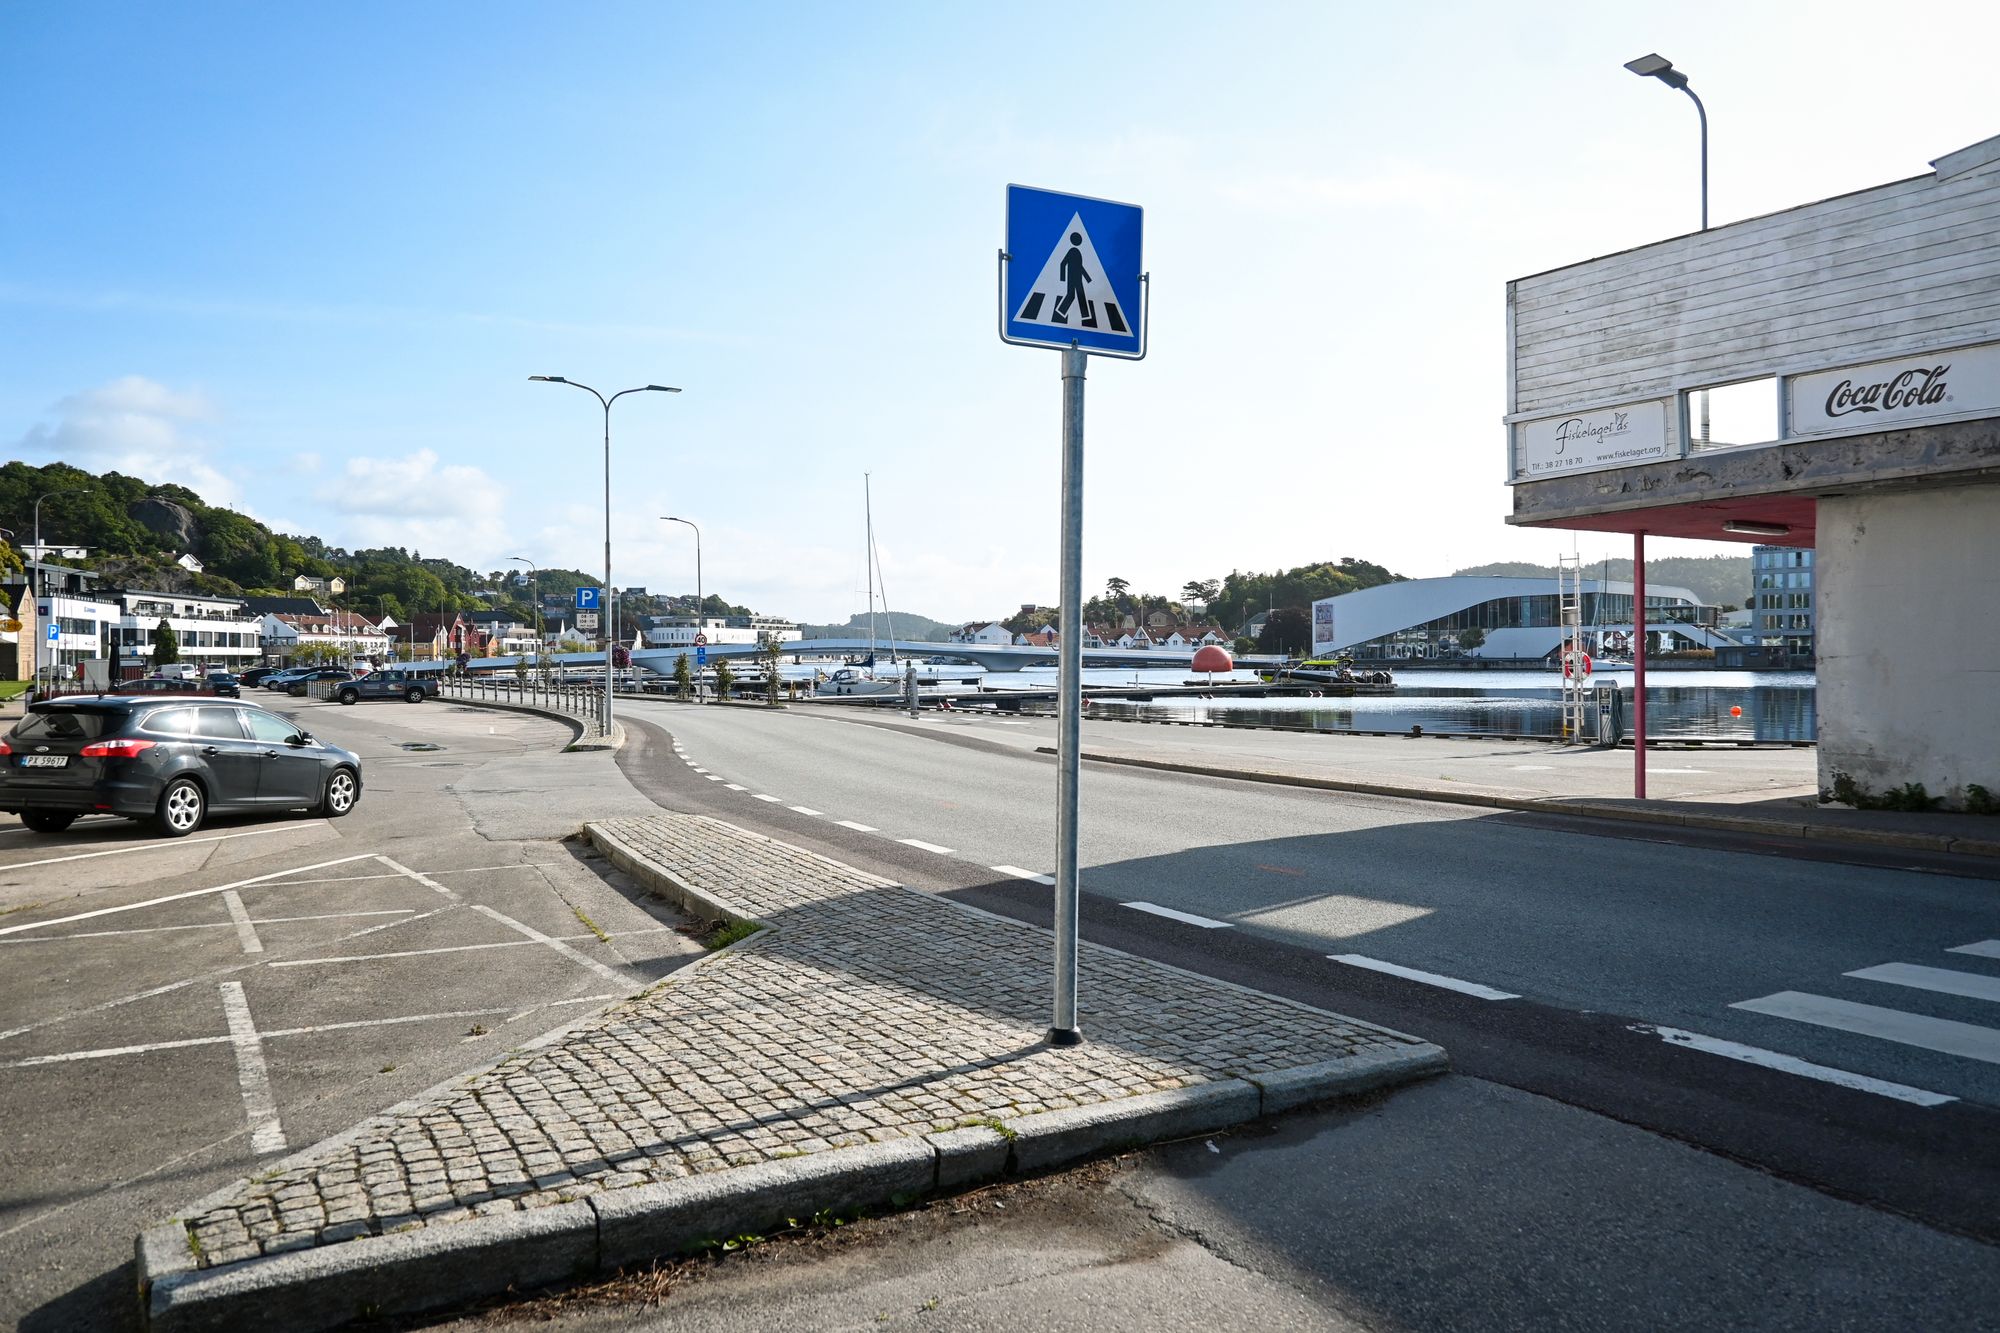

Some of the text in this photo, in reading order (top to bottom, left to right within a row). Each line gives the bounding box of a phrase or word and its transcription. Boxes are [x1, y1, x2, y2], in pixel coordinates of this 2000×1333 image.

[1825, 364, 1951, 418] Coca-Cola
[1555, 418, 1613, 455] Fiskelaget
[1597, 446, 1661, 462] www.fiskelaget.org
[1545, 461, 1554, 469] 38
[1554, 460, 1563, 468] 27
[1565, 458, 1573, 466] 18
[581, 590, 593, 606] P
[49, 627, 57, 638] P
[41, 757, 65, 765] 59617
